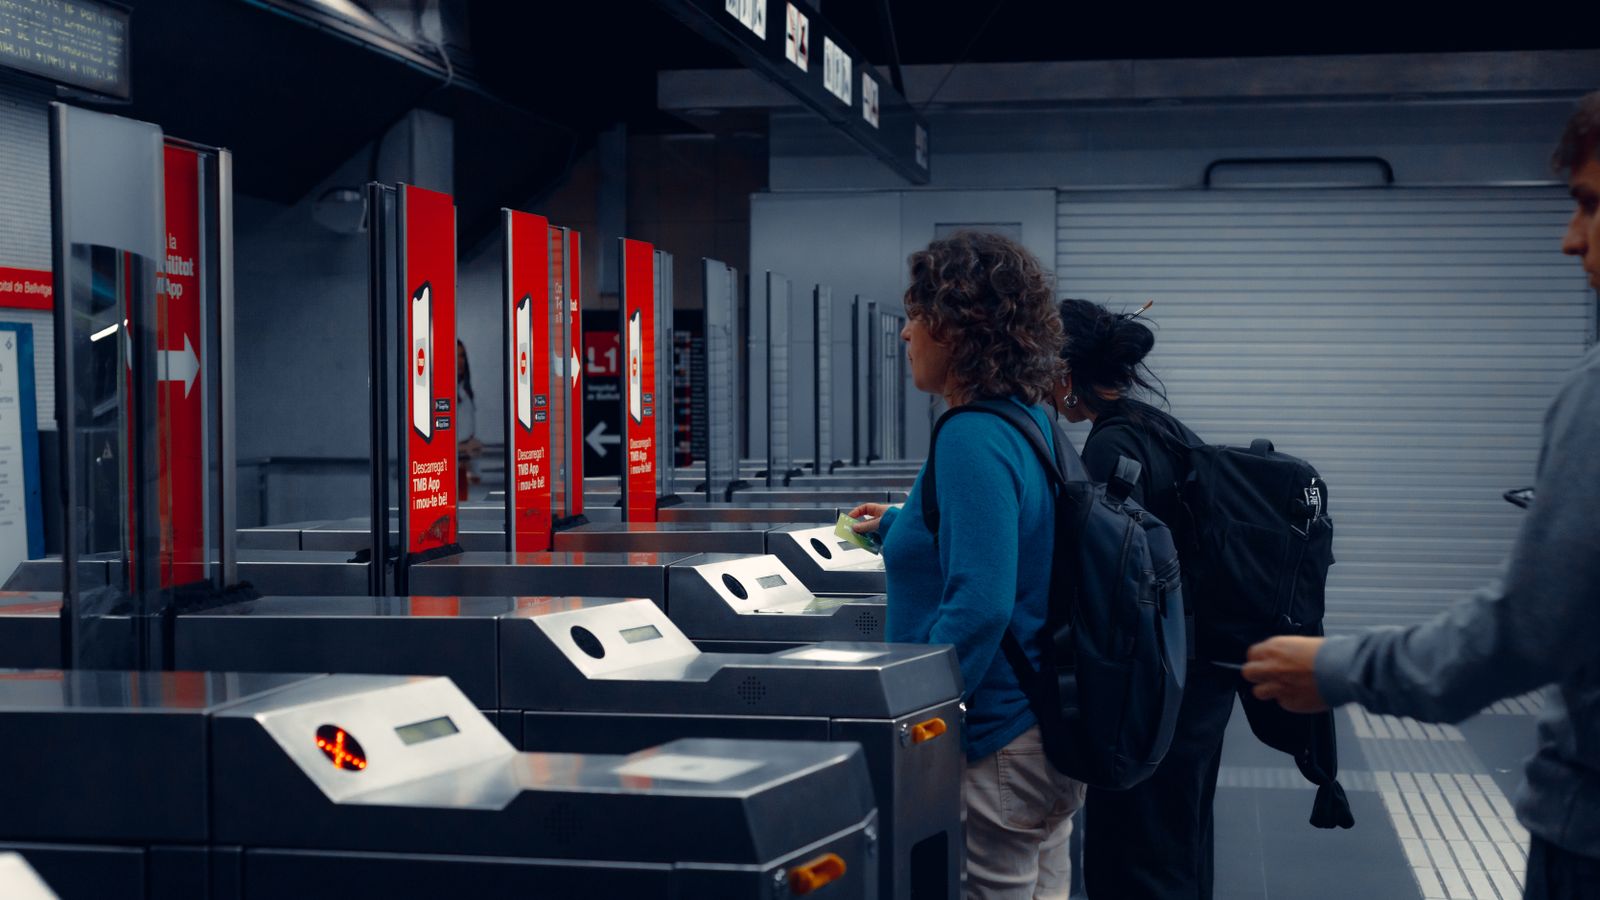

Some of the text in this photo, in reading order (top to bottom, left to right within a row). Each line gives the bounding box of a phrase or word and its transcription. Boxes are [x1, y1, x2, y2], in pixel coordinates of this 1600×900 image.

[14, 281, 23, 293] de
[587, 346, 618, 373] L1
[413, 476, 440, 493] TMB App
[416, 494, 438, 509] mou-te
